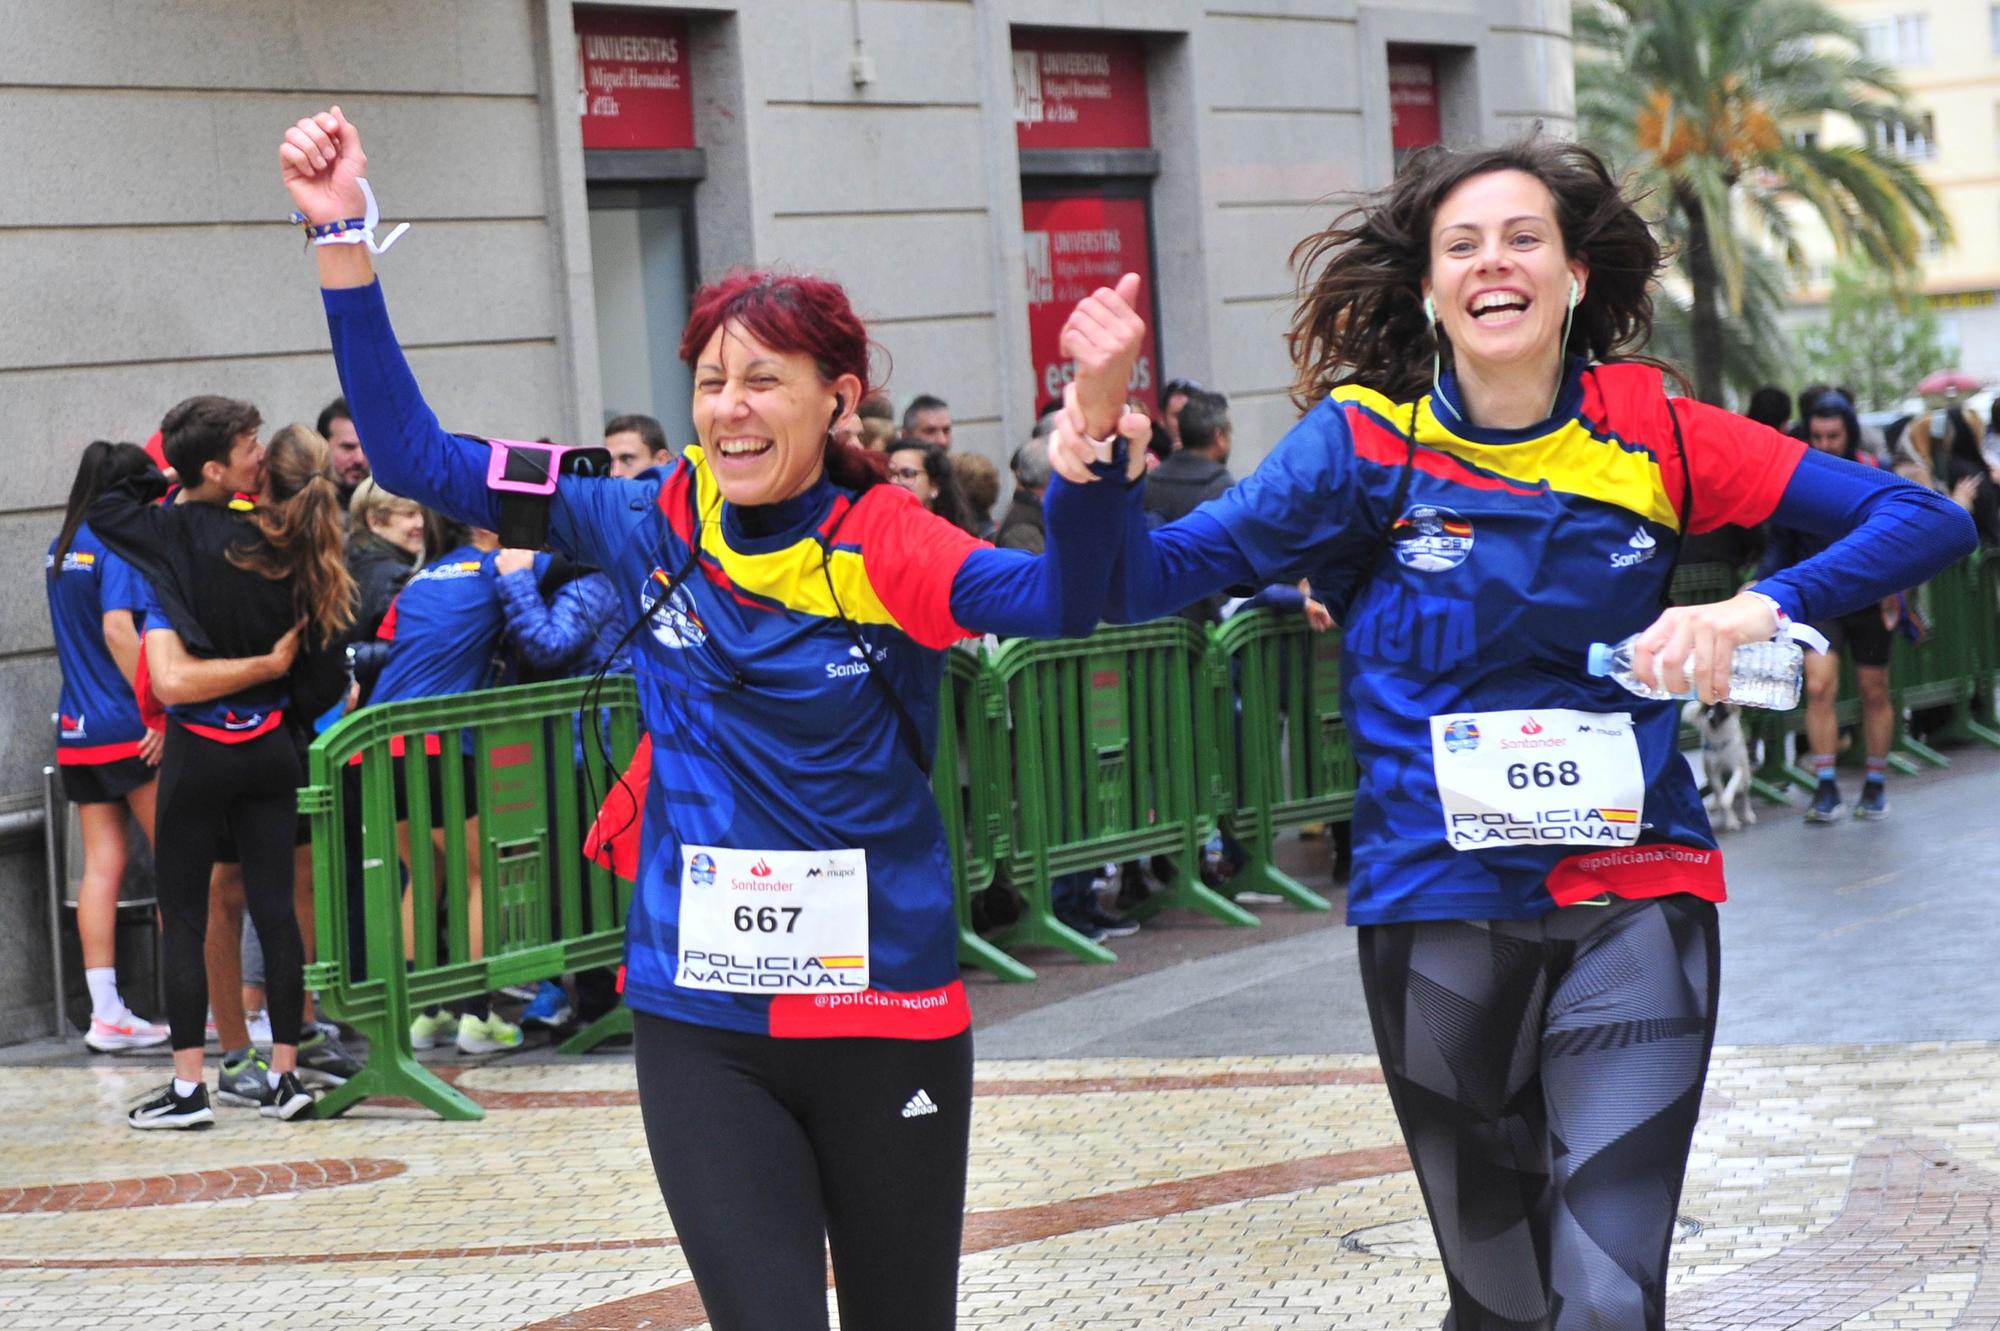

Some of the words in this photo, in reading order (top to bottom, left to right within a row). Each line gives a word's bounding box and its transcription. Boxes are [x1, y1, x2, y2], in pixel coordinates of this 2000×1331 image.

[587, 36, 679, 63] UNIVERSITAS
[1055, 230, 1121, 253] UNIVERSITAS
[825, 647, 888, 679] Santaer
[1500, 738, 1567, 750] Santander
[1507, 760, 1580, 790] 668
[1452, 808, 1606, 827] POLICIA
[1454, 826, 1635, 845] NACIONAL
[1578, 847, 1711, 871] @policianacional
[827, 867, 855, 879] mupol
[731, 879, 794, 892] Santander
[733, 905, 803, 933] 667
[683, 950, 823, 970] POLICIA
[683, 967, 866, 987] NACIONAL
[815, 991, 949, 1010] @policianacional
[901, 1104, 938, 1118] adidas
